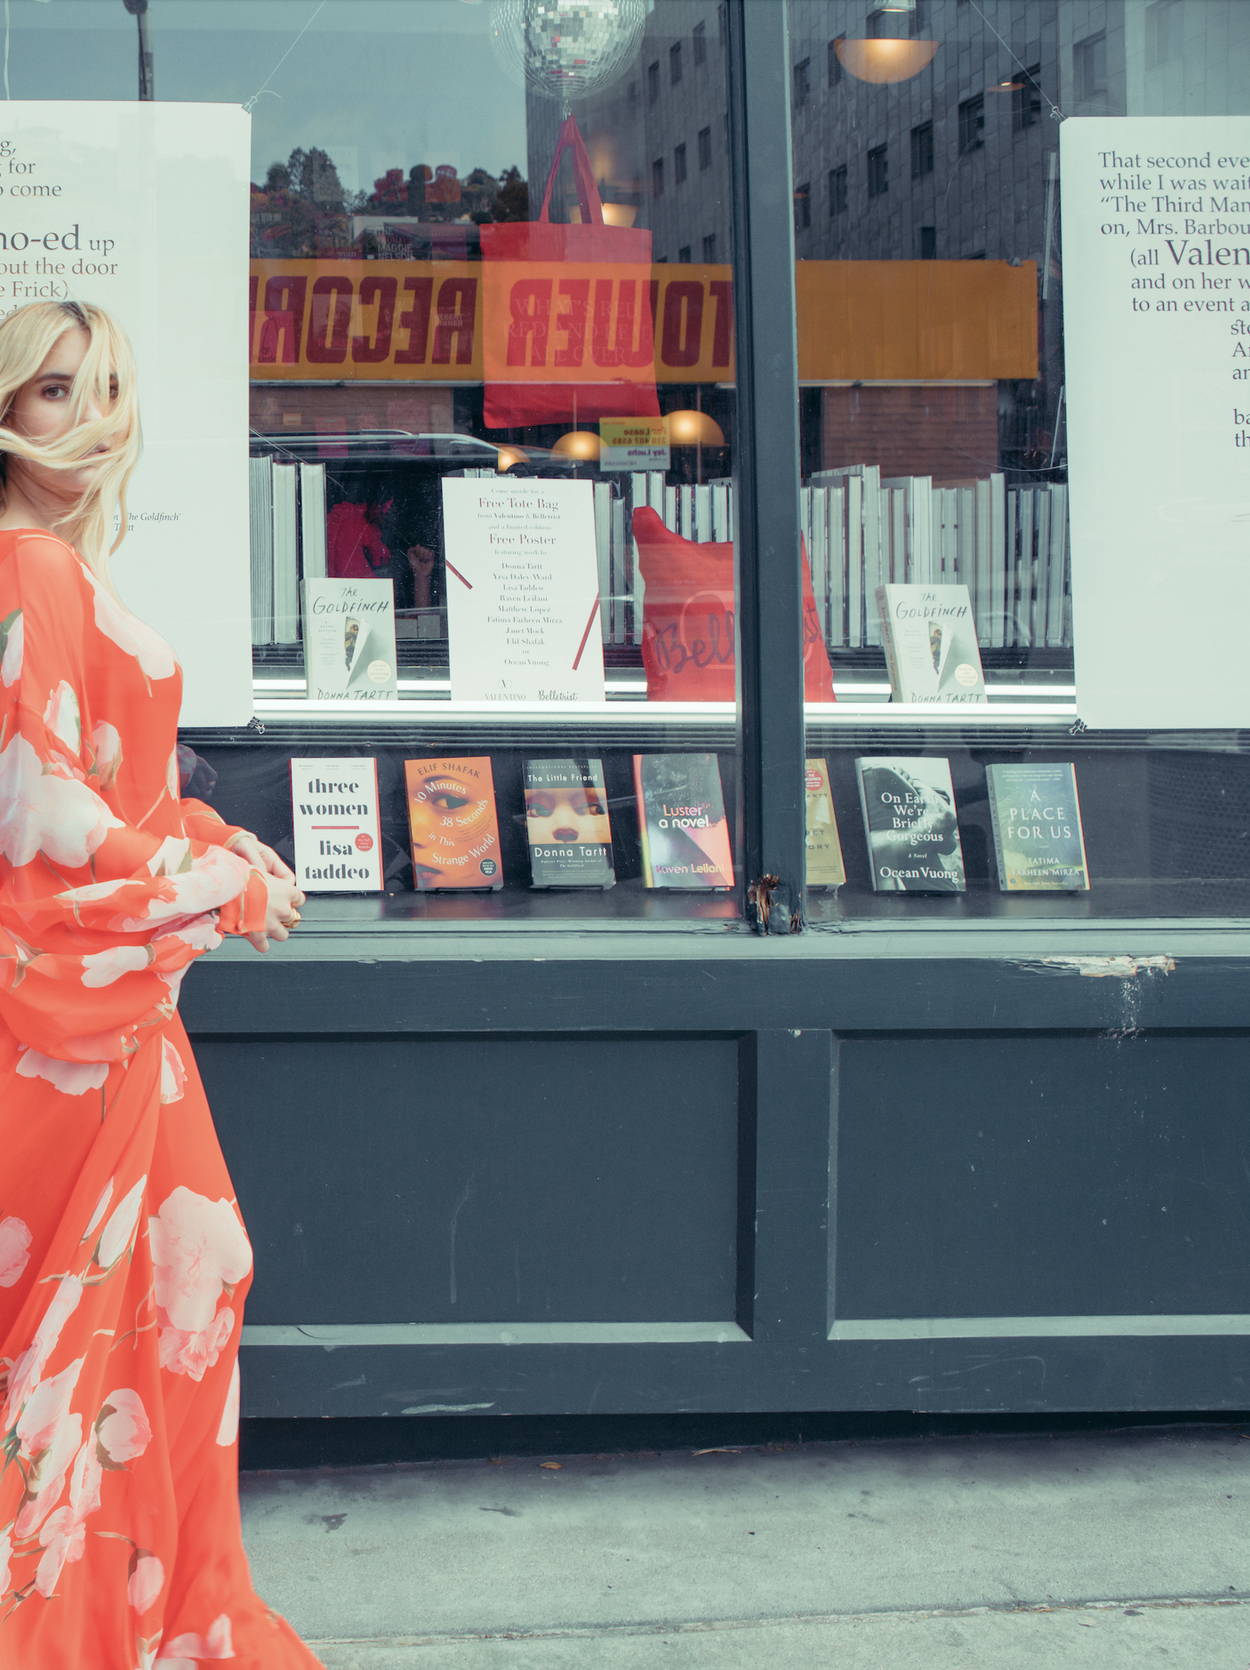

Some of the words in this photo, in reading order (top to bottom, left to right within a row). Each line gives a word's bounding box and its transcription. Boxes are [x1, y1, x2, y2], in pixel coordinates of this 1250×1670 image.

[1098, 151, 1141, 168] That
[1147, 151, 1211, 168] second
[10, 185, 62, 196] come
[1101, 223, 1130, 237] on,
[1136, 218, 1178, 235] Mrs.
[89, 239, 115, 256] up
[1131, 273, 1165, 289] and
[1172, 277, 1196, 289] on
[1201, 272, 1232, 289] her
[11, 280, 69, 300] Frick)
[479, 498, 504, 508] Free
[507, 498, 533, 508] Tote
[537, 498, 560, 512] Bag
[489, 533, 515, 544] Free
[519, 534, 557, 544] Poster
[317, 687, 349, 700] DONNA
[354, 690, 394, 700] TARTT
[538, 689, 578, 701] Belletrist
[910, 690, 942, 703] DONNA
[946, 693, 982, 703] TARTT
[417, 763, 438, 776] ELIF
[442, 762, 481, 778] SHAFAK
[527, 774, 543, 782] The
[546, 774, 567, 782] Little
[308, 778, 359, 793] three
[414, 791, 427, 804] 10
[425, 781, 467, 795] Minutes
[881, 792, 901, 803] On
[904, 792, 938, 803] Earth
[1030, 789, 1041, 801] A
[299, 804, 368, 815] women
[439, 816, 454, 828] 38
[455, 798, 488, 827] Seconds
[663, 804, 703, 817] Luster
[893, 805, 929, 816] We're
[1010, 807, 1065, 821] PLACE
[658, 818, 668, 829] a
[672, 815, 709, 829] novel
[892, 817, 934, 833] Briefly
[428, 831, 437, 841] in
[439, 835, 455, 847] This
[887, 830, 944, 846] Gorgeous
[1007, 826, 1043, 839] FOR
[1050, 825, 1072, 839] US
[320, 840, 353, 855] lisa
[431, 852, 470, 866] Strange
[468, 833, 495, 858] World
[534, 847, 573, 857] Donna
[579, 846, 607, 856] Tartt
[305, 864, 370, 880] taddeo
[655, 864, 689, 874] Raven
[690, 863, 725, 873] Leilani
[879, 866, 919, 878] Ocean
[920, 866, 960, 883] Vuong
